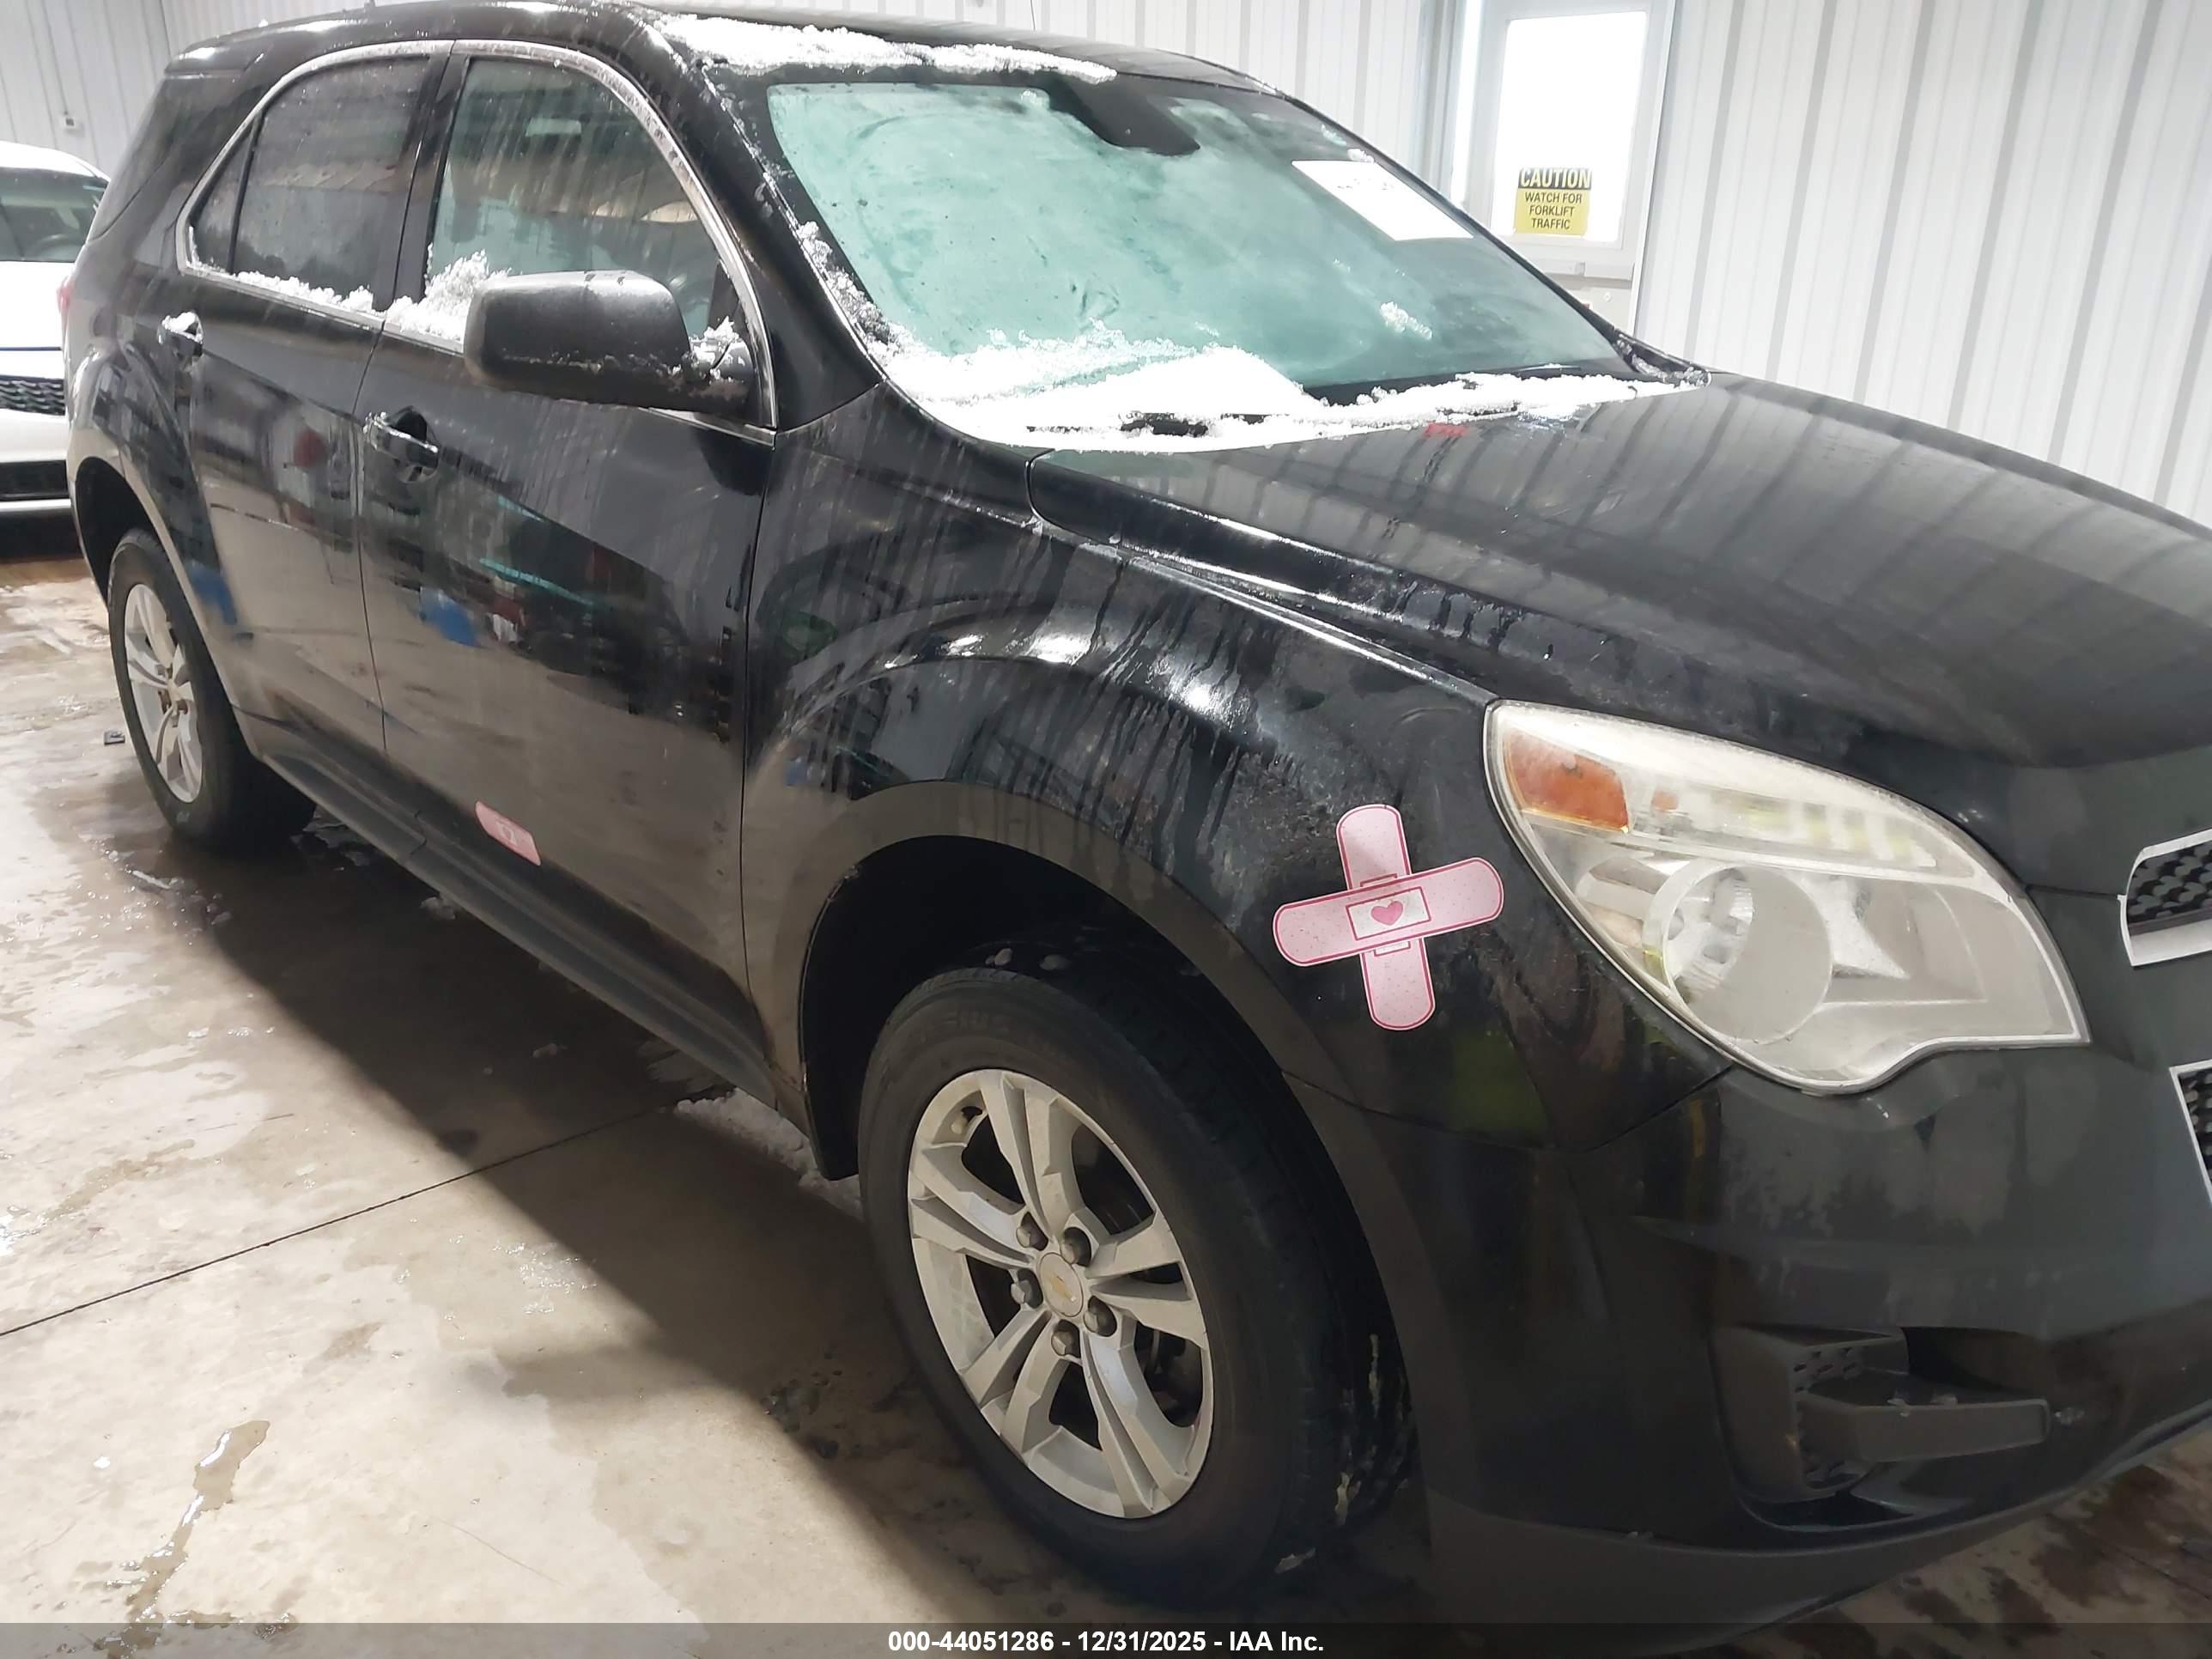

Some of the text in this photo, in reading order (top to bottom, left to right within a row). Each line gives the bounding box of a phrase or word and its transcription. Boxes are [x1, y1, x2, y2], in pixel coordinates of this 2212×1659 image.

[1519, 167, 1591, 188] CAUTION
[1525, 191, 1583, 204] WATCH FOR
[1529, 205, 1575, 216] FORKLIFT
[1532, 217, 1571, 230] TRAFFIC
